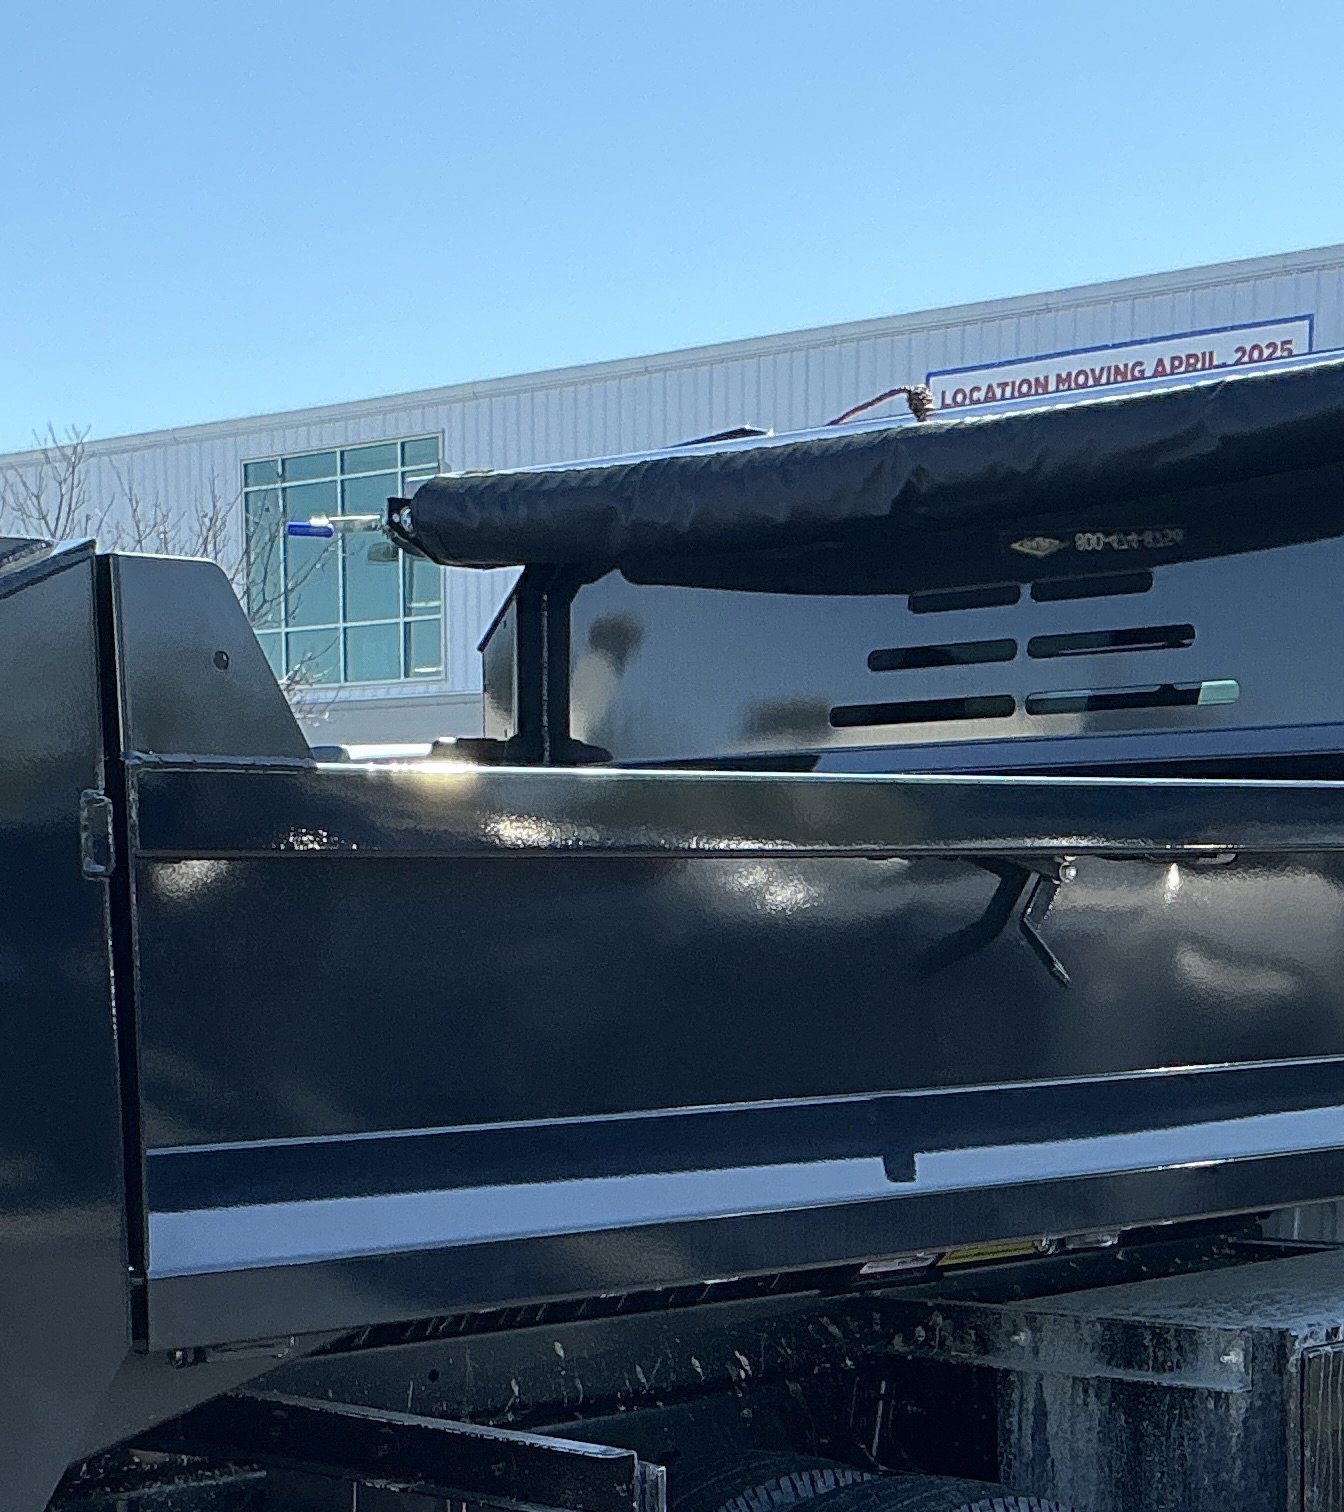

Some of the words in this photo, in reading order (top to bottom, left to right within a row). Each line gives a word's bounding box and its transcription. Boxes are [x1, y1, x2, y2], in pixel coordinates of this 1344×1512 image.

[941, 376, 1049, 409] LOCATION
[1056, 361, 1146, 391] MOVING
[1233, 340, 1294, 365] 2025
